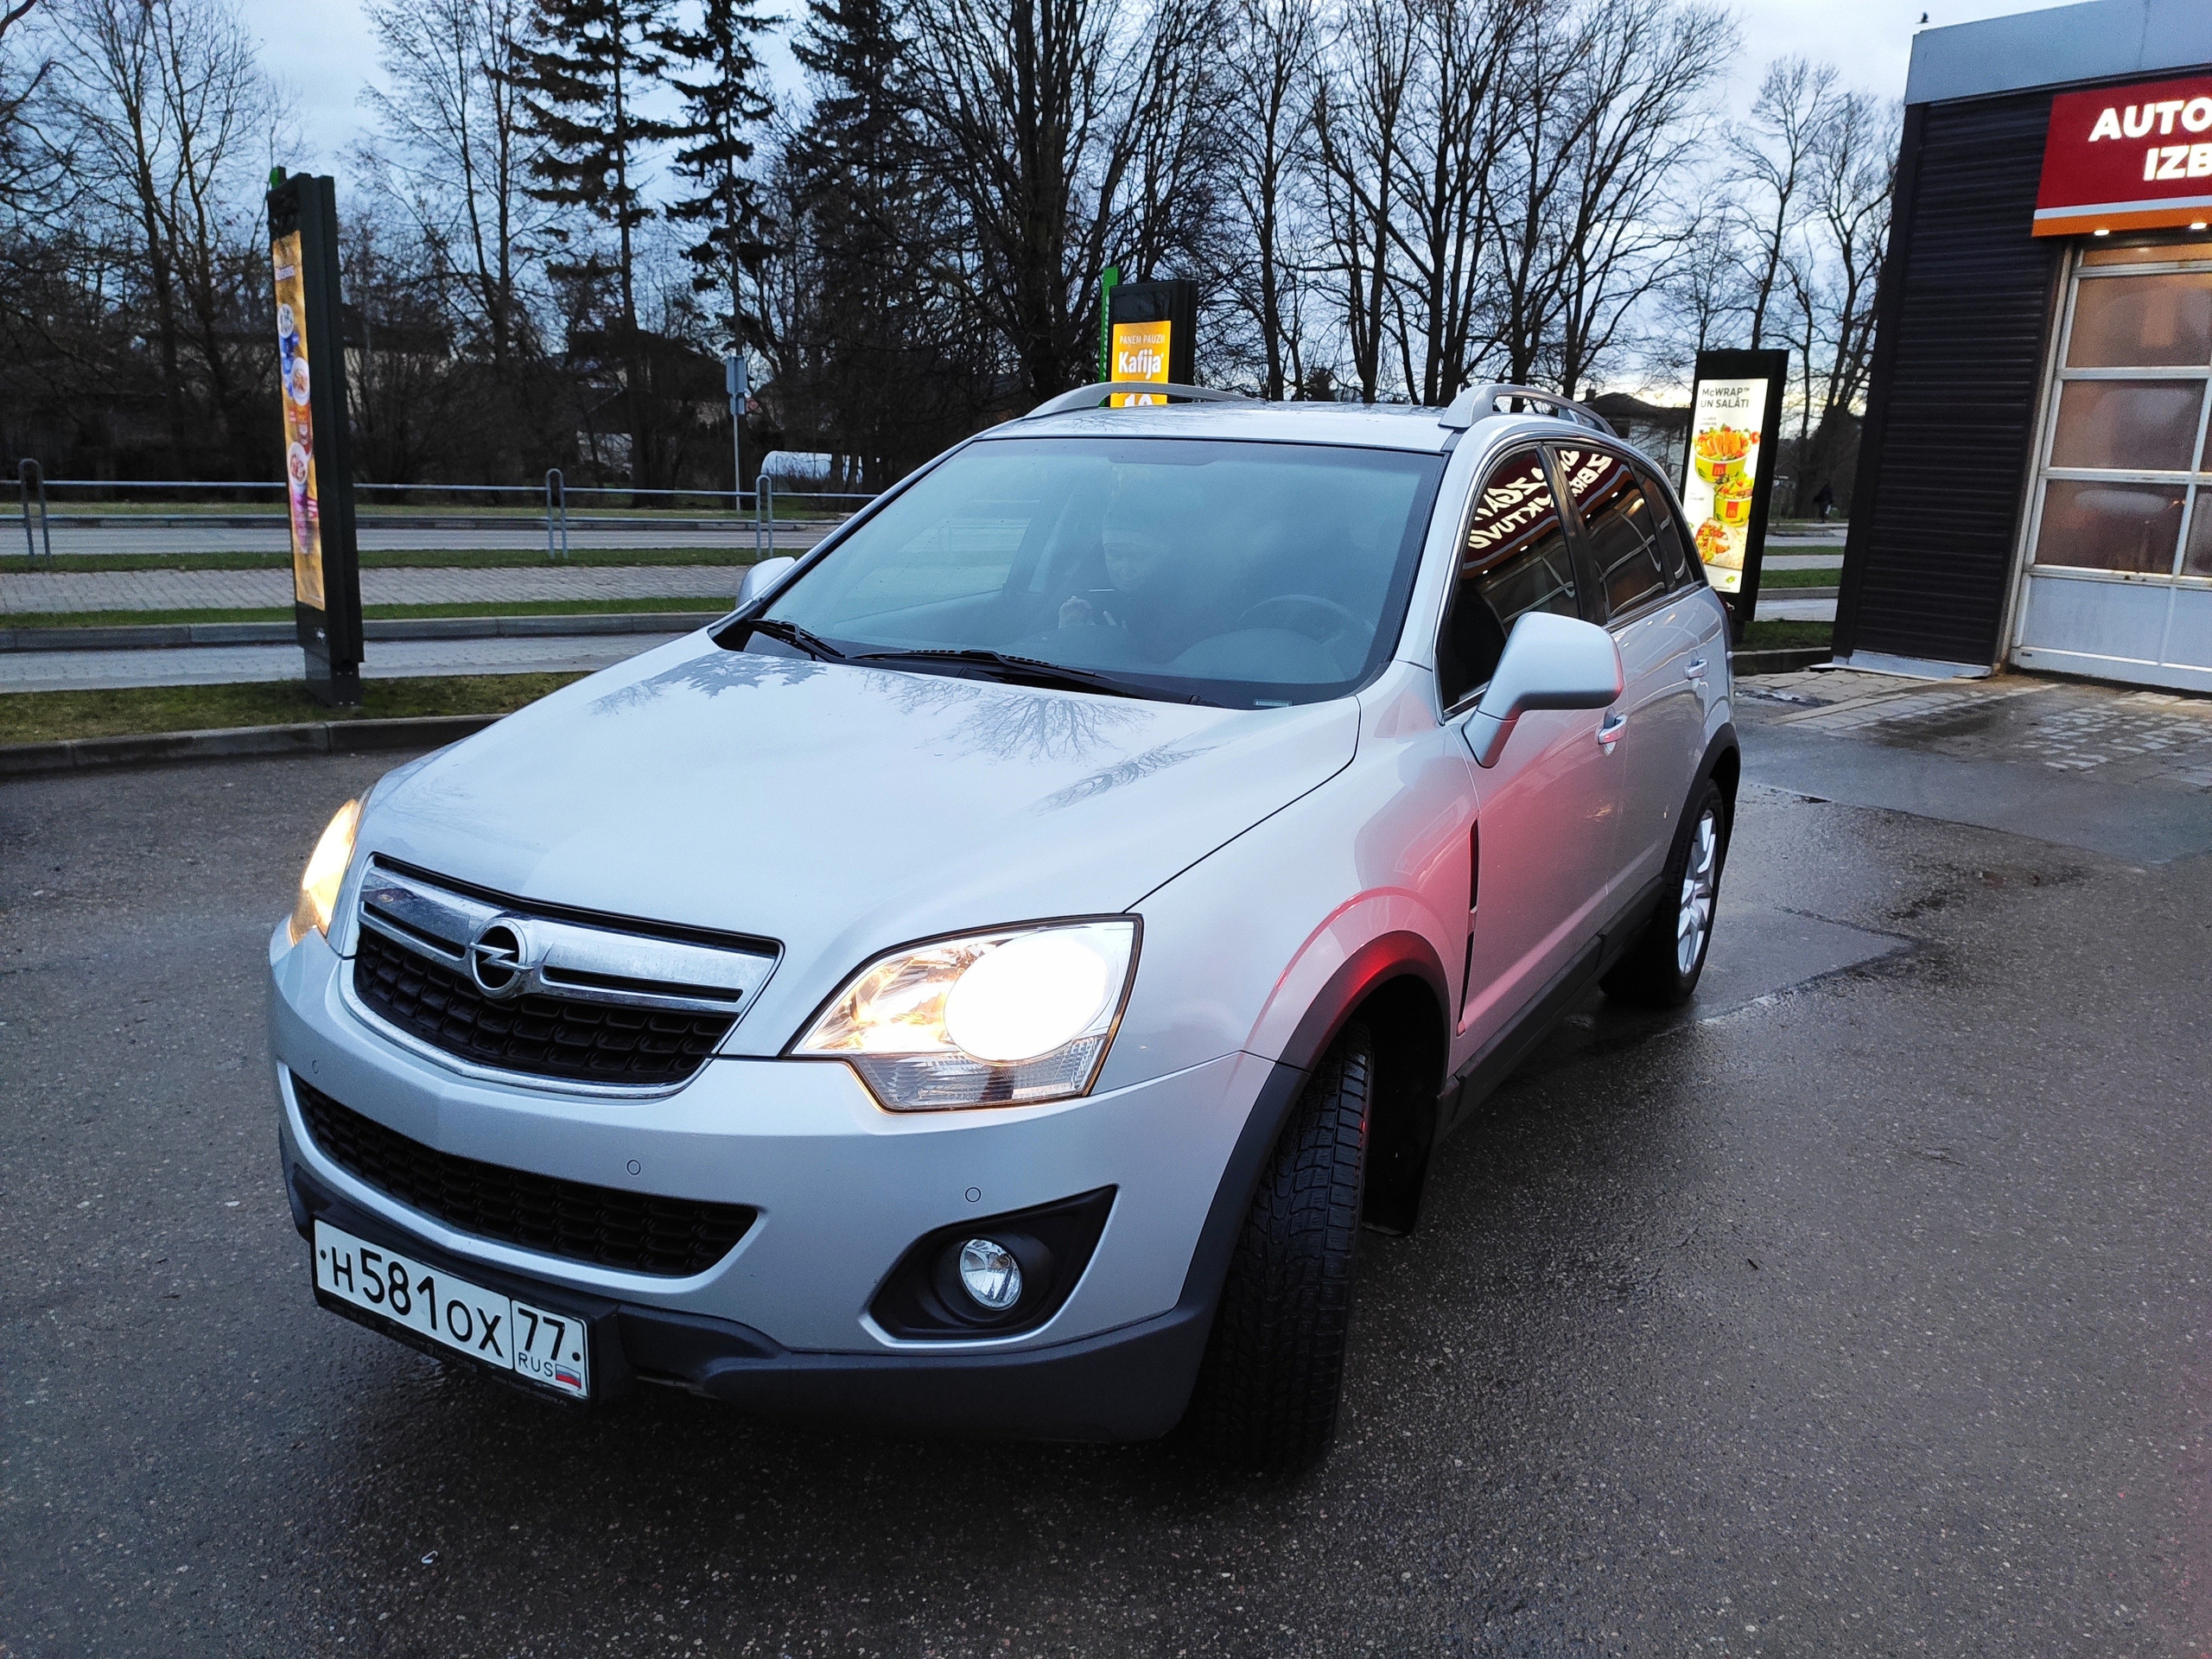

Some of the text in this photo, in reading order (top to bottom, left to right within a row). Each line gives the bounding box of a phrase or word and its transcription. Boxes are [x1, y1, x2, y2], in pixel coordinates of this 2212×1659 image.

[2088, 97, 2212, 143] AUTO
[1700, 399, 1713, 408] UN
[518, 1307, 565, 1361] 77
[518, 1351, 554, 1377] RUS
